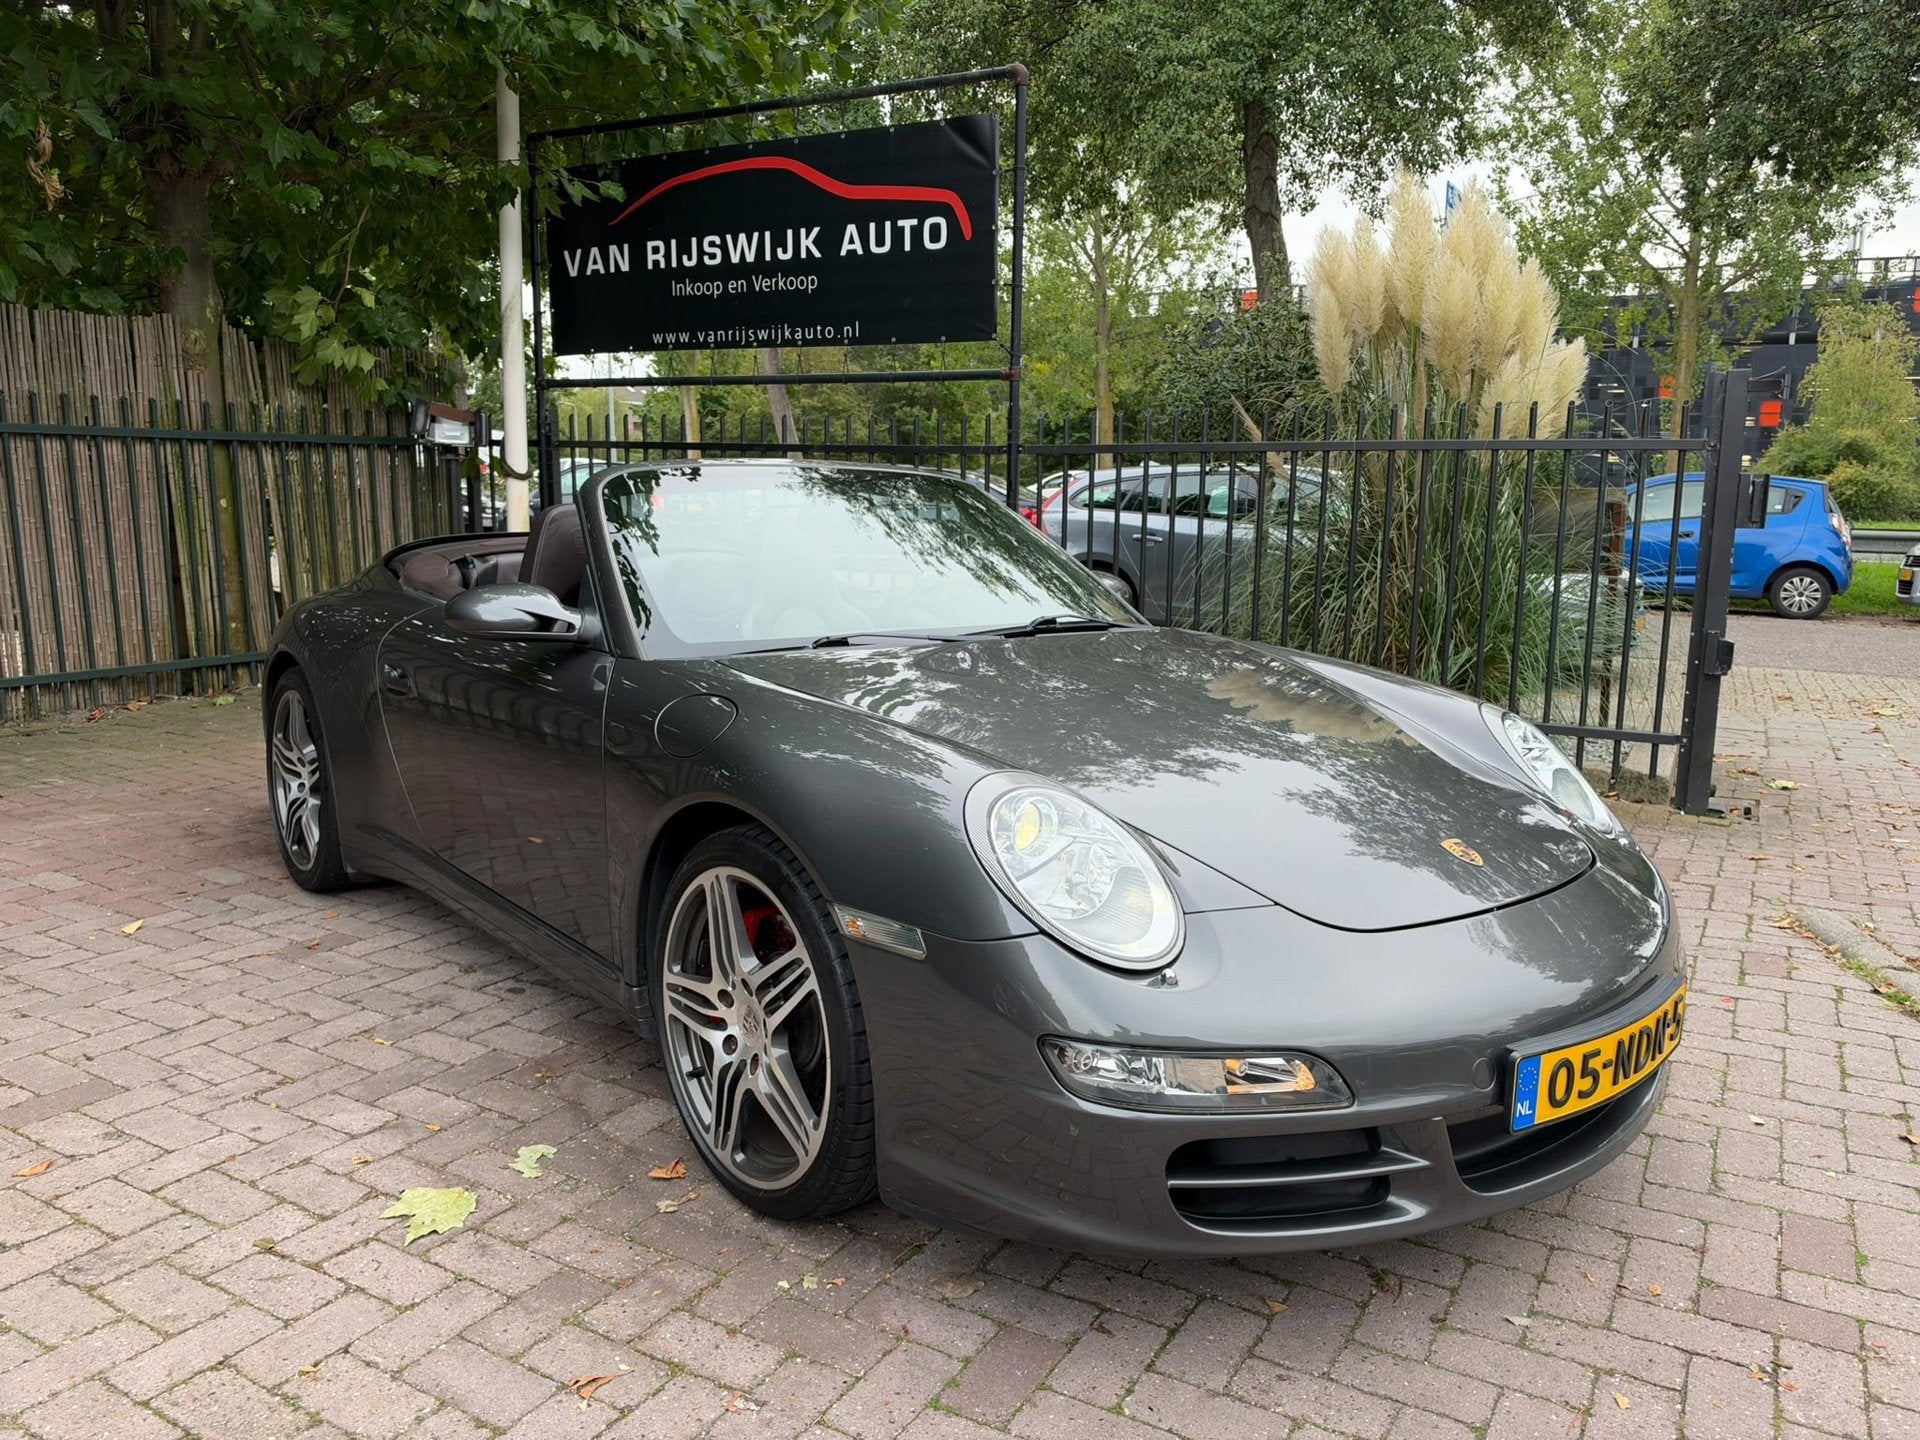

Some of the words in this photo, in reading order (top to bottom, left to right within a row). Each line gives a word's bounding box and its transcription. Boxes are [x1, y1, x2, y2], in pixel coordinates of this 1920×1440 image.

[564, 244, 629, 277] VAN
[647, 227, 822, 269] RIJSWIJK
[840, 216, 947, 256] AUTO
[672, 279, 722, 298] Inkoop
[728, 280, 746, 293] en
[752, 273, 817, 293] Verkoop
[653, 321, 859, 344] www.vanrijswijkauto.nl
[1516, 1100, 1533, 1118] NL
